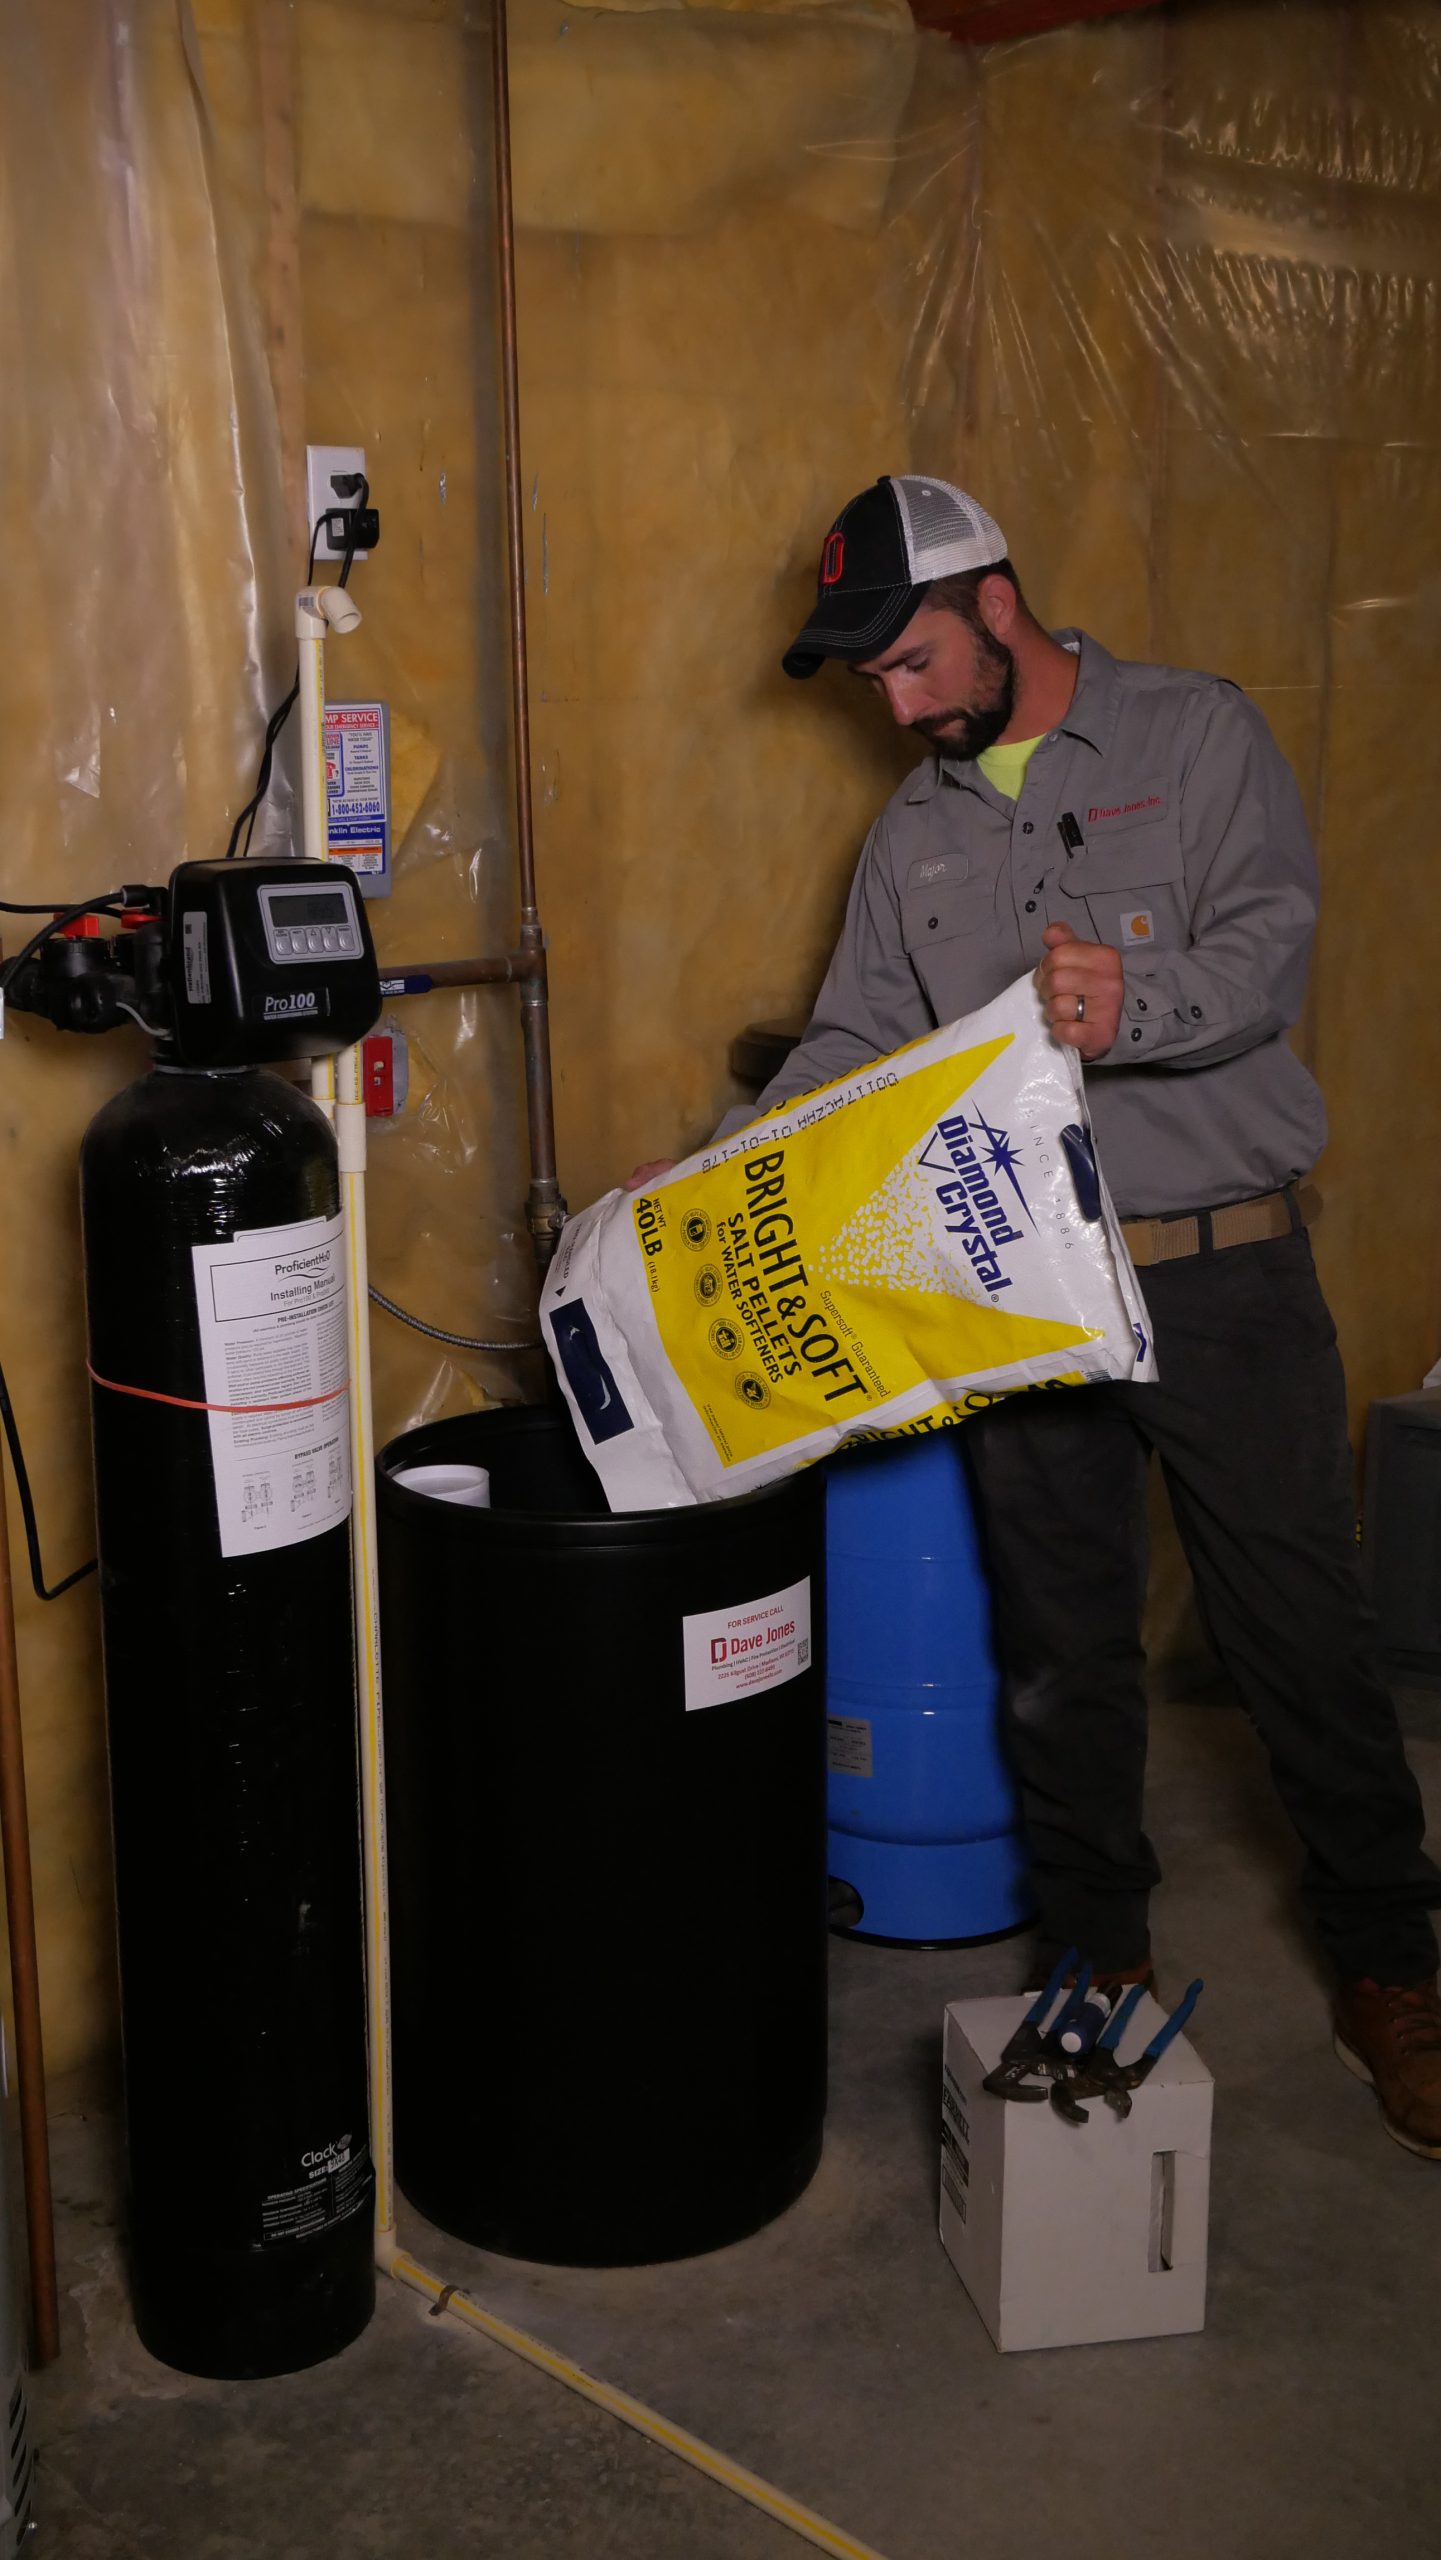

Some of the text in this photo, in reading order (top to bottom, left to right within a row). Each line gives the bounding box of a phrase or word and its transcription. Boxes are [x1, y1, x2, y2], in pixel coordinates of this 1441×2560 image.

[341, 712, 378, 724] SERVICE
[350, 826, 381, 834] Electric
[265, 992, 316, 1012] Pro100
[937, 1114, 1025, 1247] Diamond
[1024, 1109, 1074, 1250] SINCE 1886
[636, 1198, 663, 1257] 40LB
[653, 1197, 667, 1228] NET WT
[716, 1221, 727, 1244] for
[935, 1180, 1013, 1292] Crystal
[270, 1273, 336, 1301] Installing Manual
[721, 1245, 743, 1301] WATER
[727, 1212, 755, 1268] SALT
[742, 1276, 802, 1376] PELLETS
[744, 1150, 868, 1401] BRIGHT & SOFT
[736, 1301, 783, 1383] SOFTENERS
[851, 1341, 891, 1398] Guaranteed
[727, 1605, 784, 1629] FOR SERVICE CALL
[731, 1633, 763, 1656] Dave
[766, 1620, 796, 1645] Jones
[301, 2142, 338, 2167] Clack
